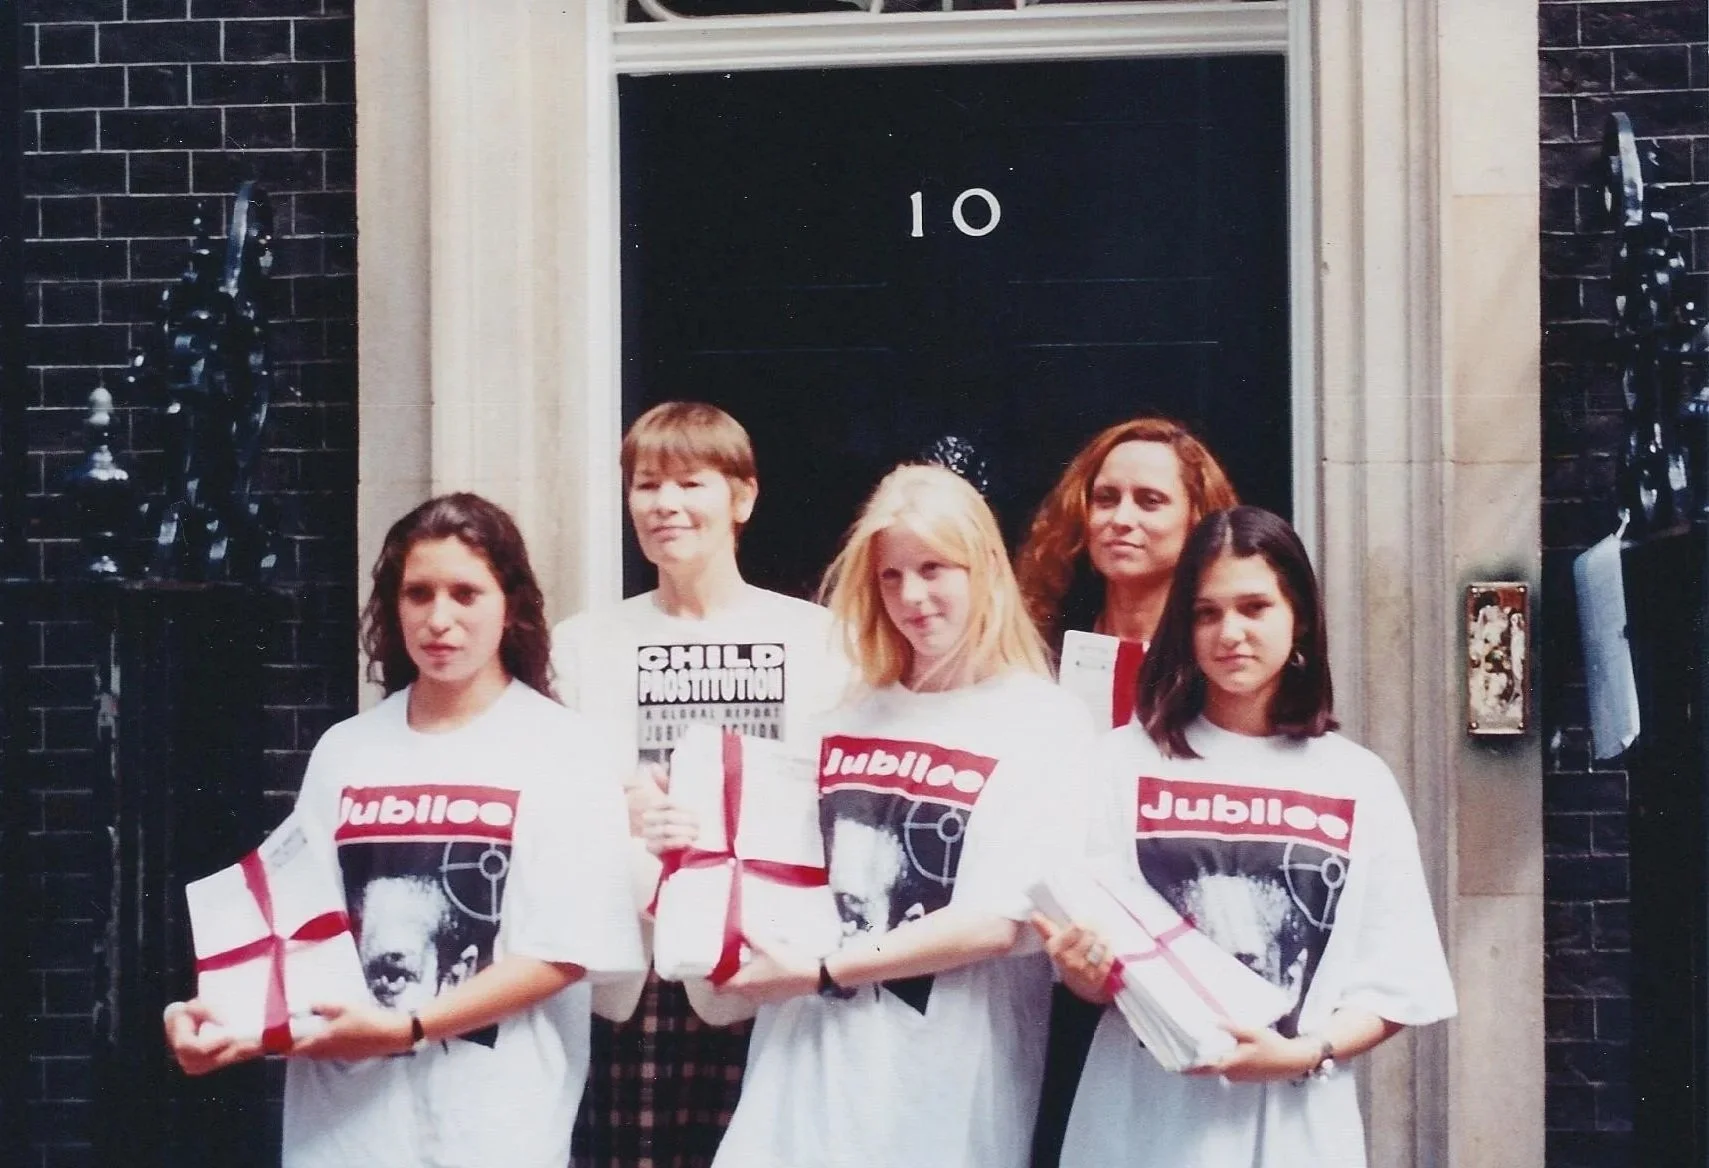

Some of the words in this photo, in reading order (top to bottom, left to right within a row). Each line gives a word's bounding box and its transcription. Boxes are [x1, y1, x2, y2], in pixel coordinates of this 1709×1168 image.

[910, 188, 1001, 237] 10
[638, 644, 785, 670] CHILD
[638, 667, 784, 703] PROSTITUTION
[661, 708, 715, 720] GLOBAL
[724, 707, 780, 719] REPORT
[822, 747, 985, 793] Jubilee
[340, 794, 513, 826] Jubilee
[1140, 790, 1349, 840] Jubilee
